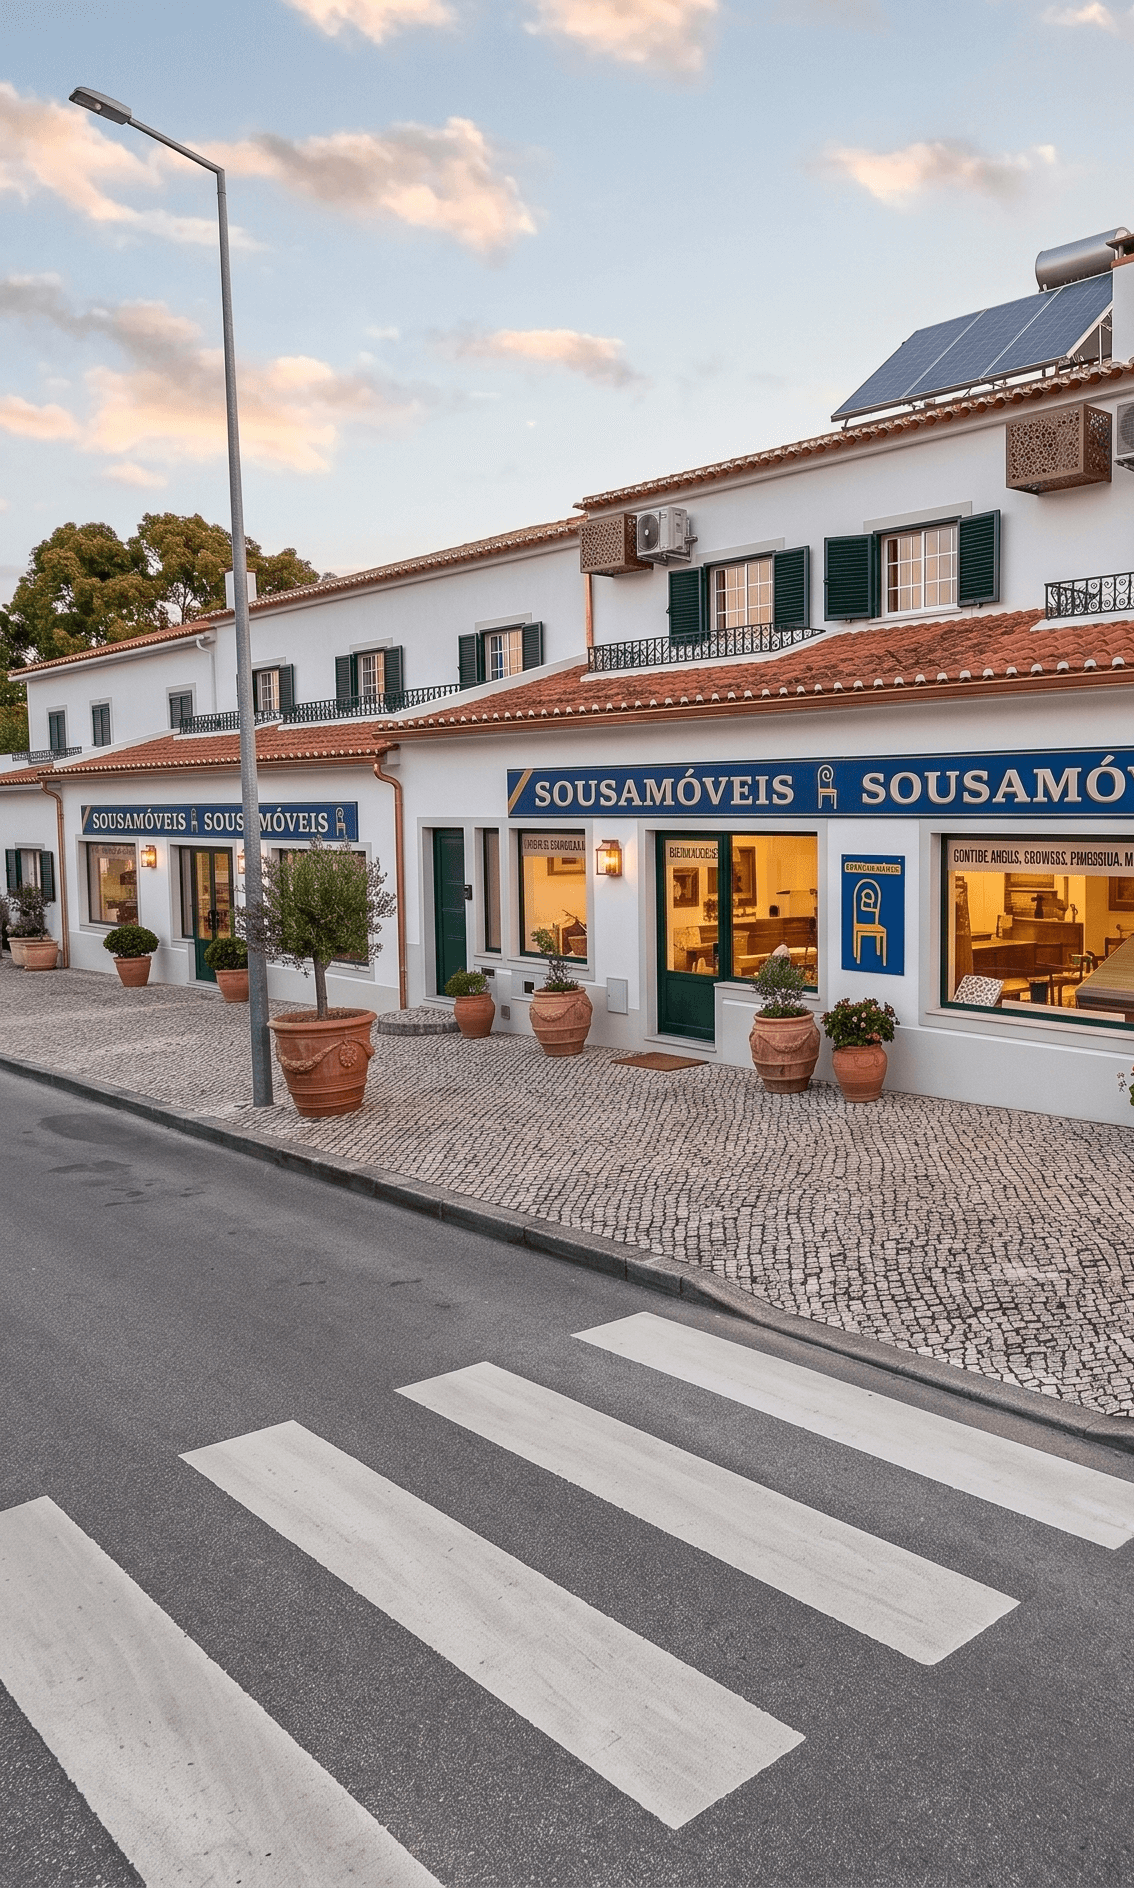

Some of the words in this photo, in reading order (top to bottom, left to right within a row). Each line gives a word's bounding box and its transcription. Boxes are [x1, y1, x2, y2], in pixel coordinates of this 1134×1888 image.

[534, 768, 795, 807] SOUSAMÓVEIS
[92, 808, 187, 830] SOUSAMÓVEIS
[204, 807, 329, 833] SOUSMÓVEIS
